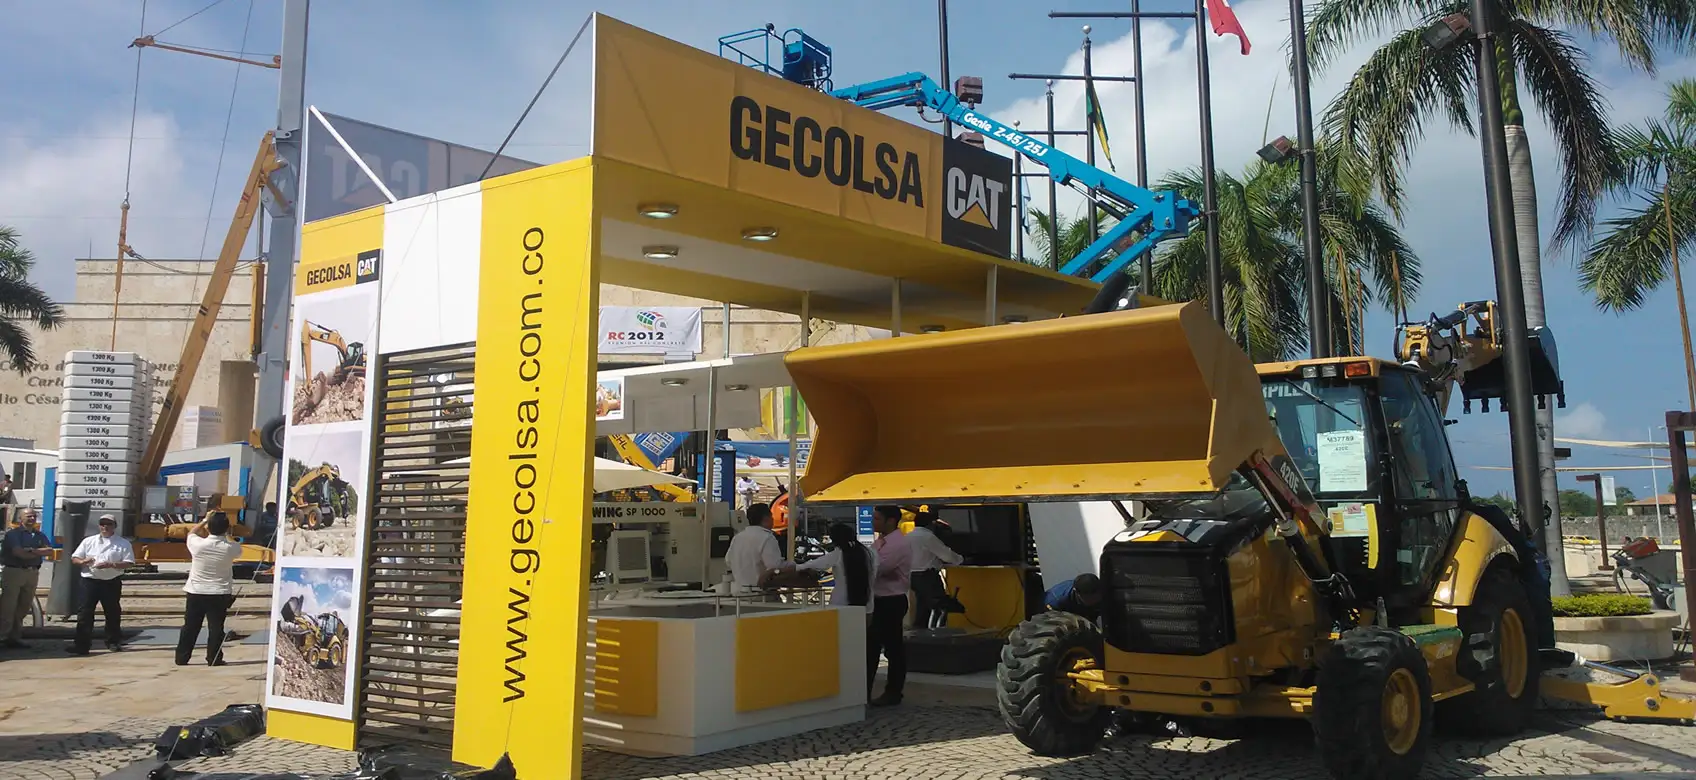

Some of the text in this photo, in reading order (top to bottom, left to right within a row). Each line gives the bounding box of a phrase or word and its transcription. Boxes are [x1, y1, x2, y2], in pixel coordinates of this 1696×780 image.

[964, 112, 992, 132] Genie
[730, 95, 1004, 230] GECOLSA CAT
[306, 257, 377, 286] GECOLSA CAT
[607, 331, 664, 340] RC 2012
[502, 226, 544, 704] www.gecolsa.com.co
[1280, 461, 1300, 495] 420E
[626, 508, 637, 516] SP
[641, 508, 666, 516] 1000
[1114, 519, 1228, 542] CAT
